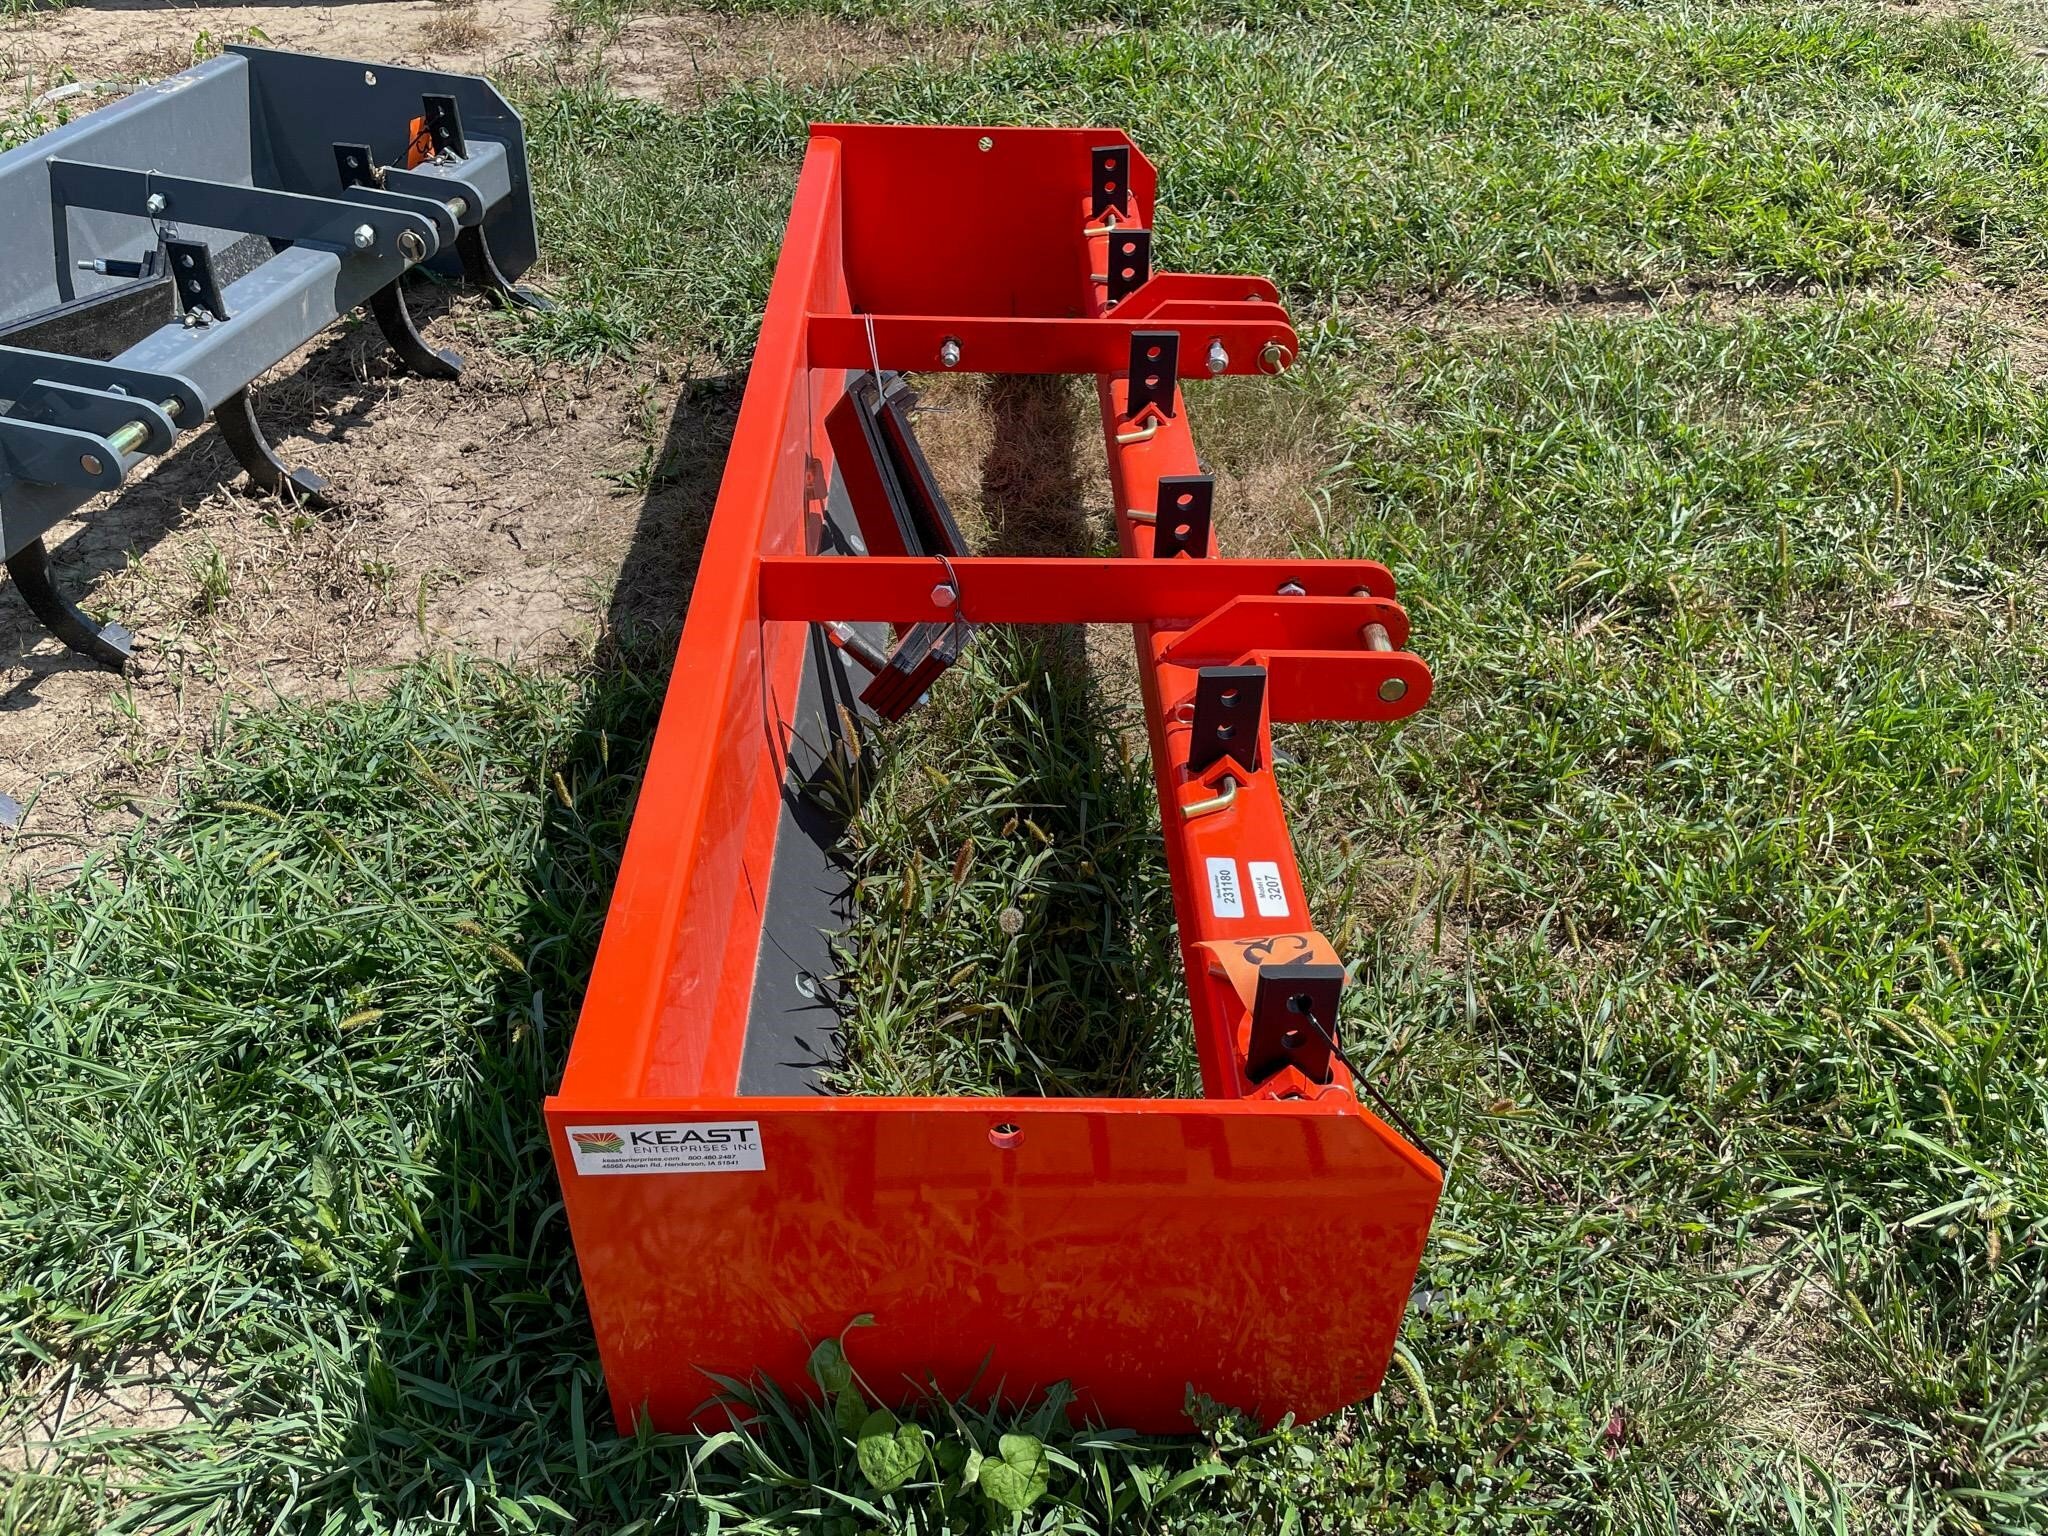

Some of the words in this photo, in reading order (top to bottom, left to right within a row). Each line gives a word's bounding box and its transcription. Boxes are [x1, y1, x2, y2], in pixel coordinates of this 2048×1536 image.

[1219, 869, 1236, 904] 231180
[1256, 881, 1266, 898] Model
[1264, 875, 1282, 901] 3207
[630, 1128, 754, 1146] KEAST
[633, 1144, 729, 1154] ENTERPRISES
[733, 1143, 758, 1151] INC
